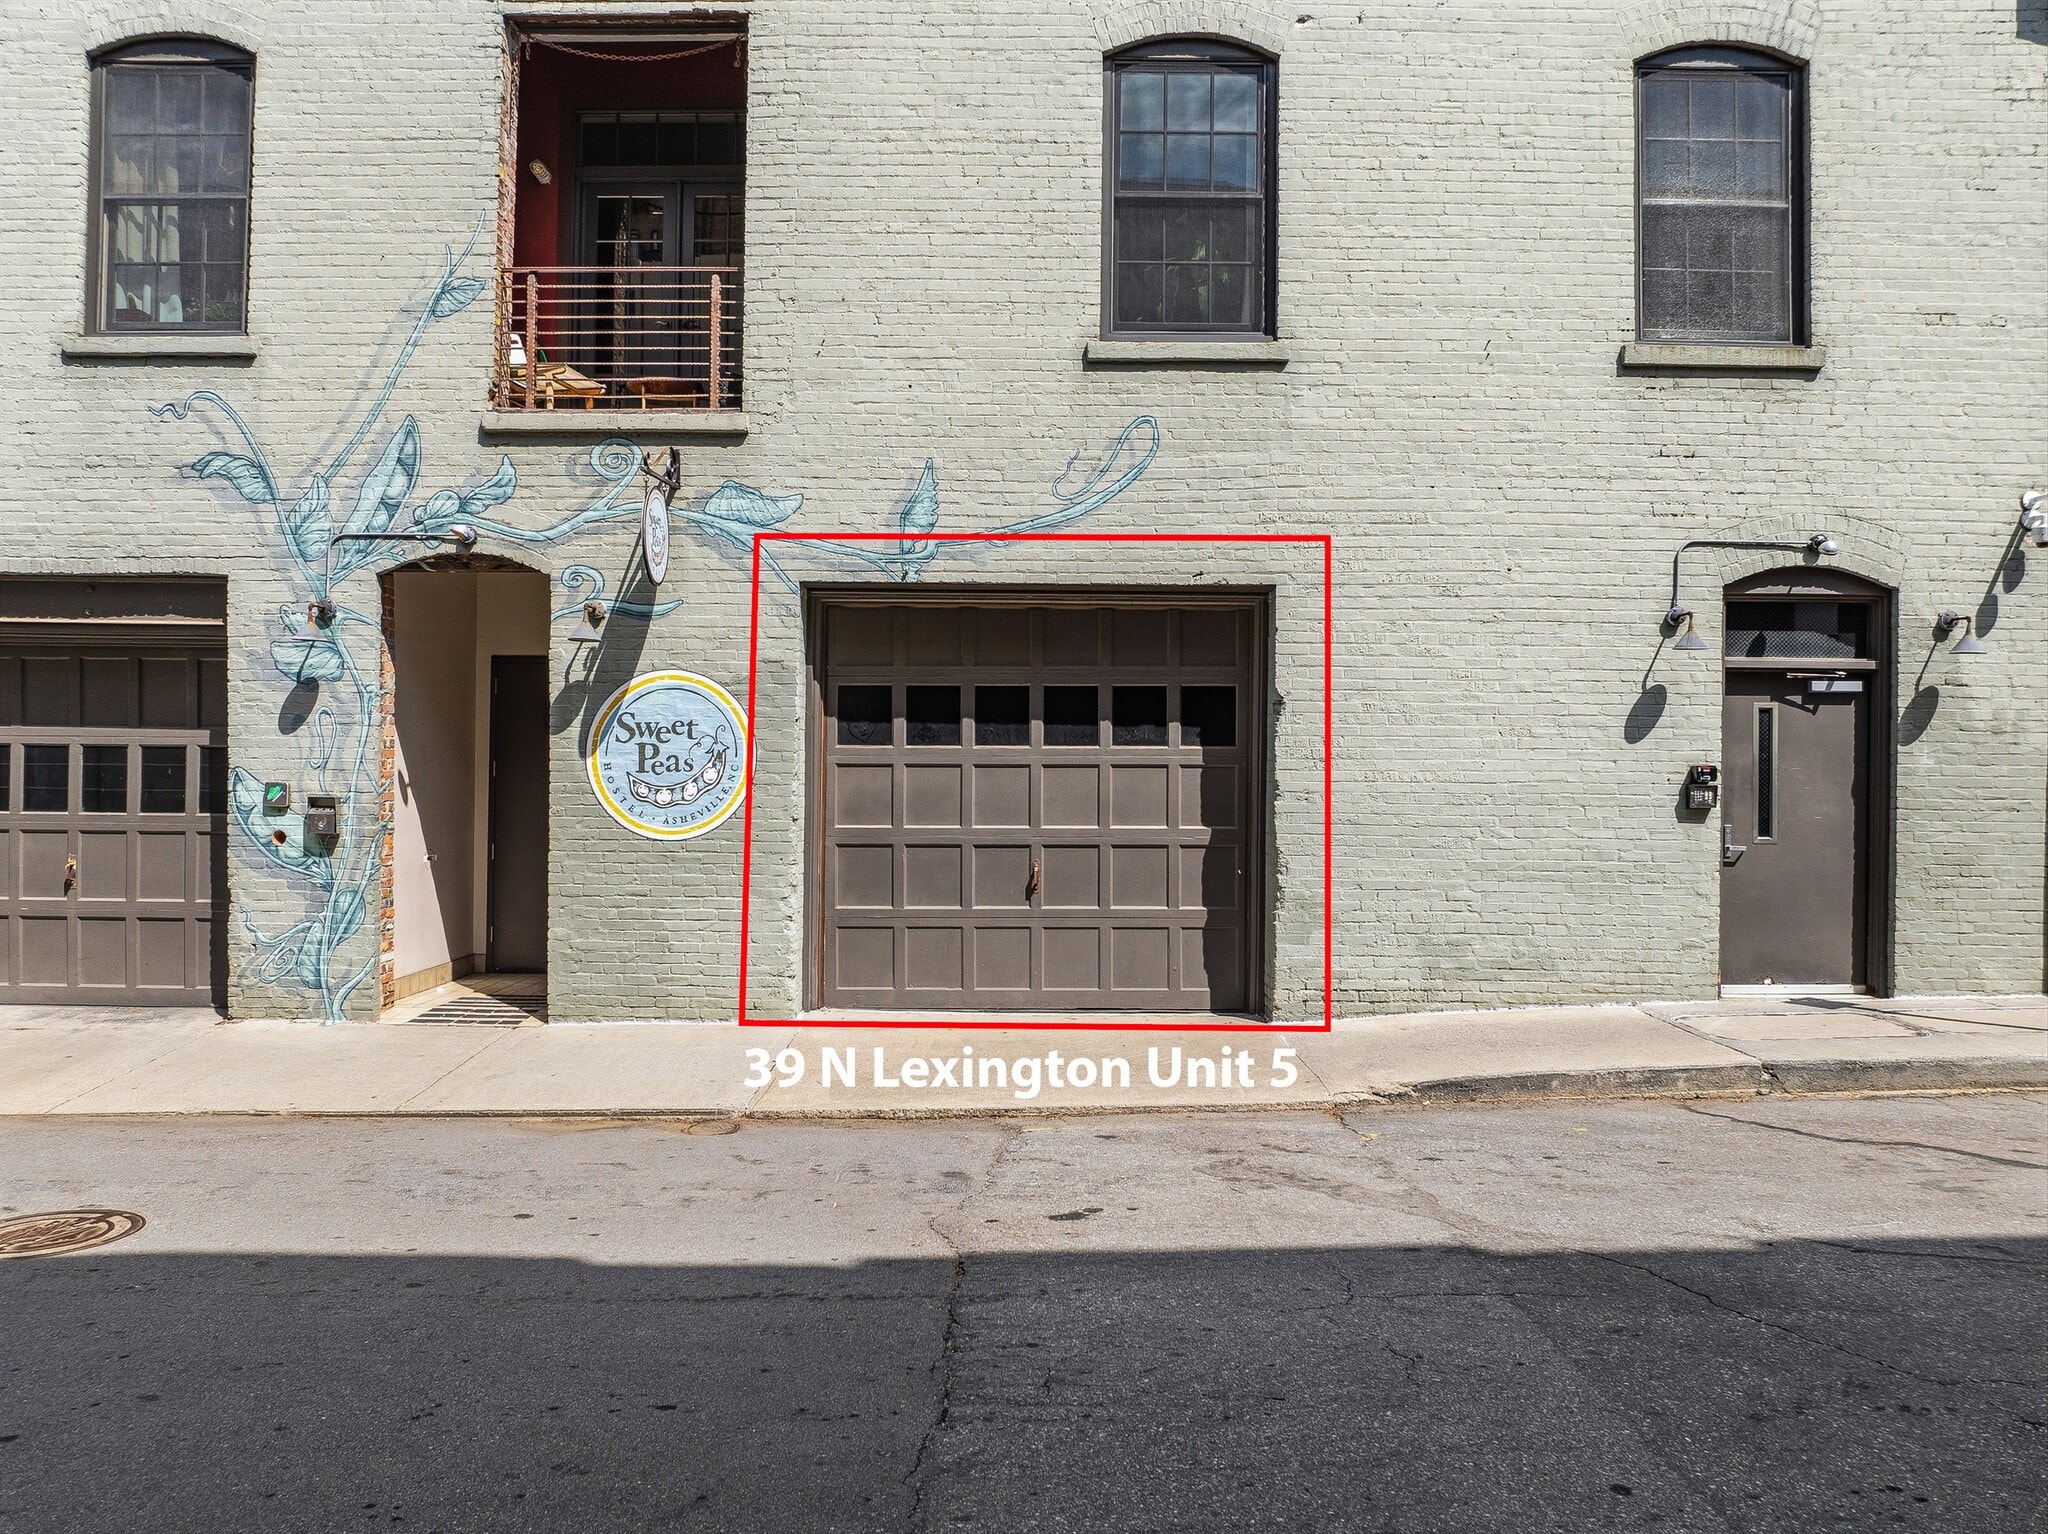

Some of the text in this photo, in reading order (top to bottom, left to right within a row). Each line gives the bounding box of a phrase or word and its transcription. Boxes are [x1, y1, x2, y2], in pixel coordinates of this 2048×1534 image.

[615, 712, 699, 743] Sweet
[635, 742, 694, 775] Peas
[604, 762, 646, 819] HOSTEL
